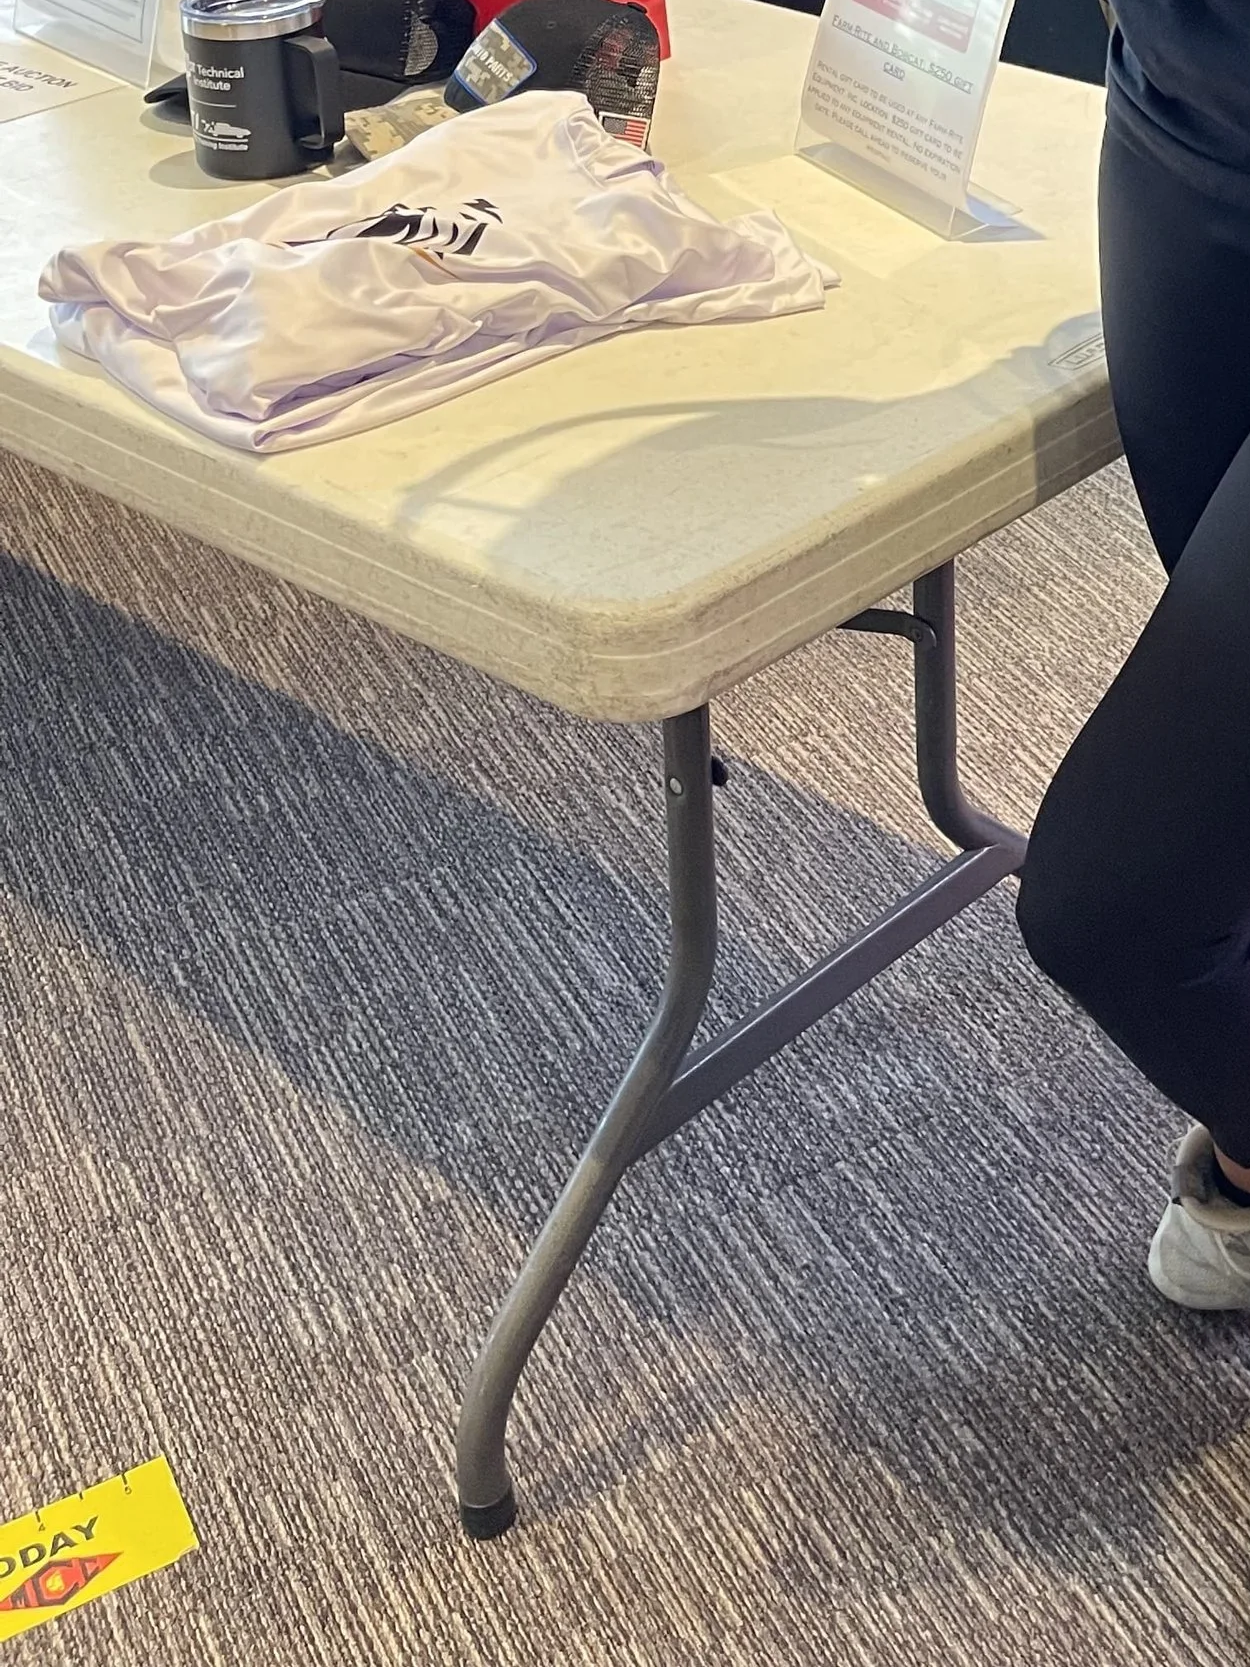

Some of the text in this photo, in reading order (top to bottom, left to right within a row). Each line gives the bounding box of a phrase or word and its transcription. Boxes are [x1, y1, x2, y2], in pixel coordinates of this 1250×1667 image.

[7, 65, 79, 88] AUCTION
[197, 63, 245, 79] Technical
[485, 56, 514, 82] PARTS
[883, 62, 906, 80] CARD
[929, 62, 953, 83] $250
[193, 76, 231, 91] Institute
